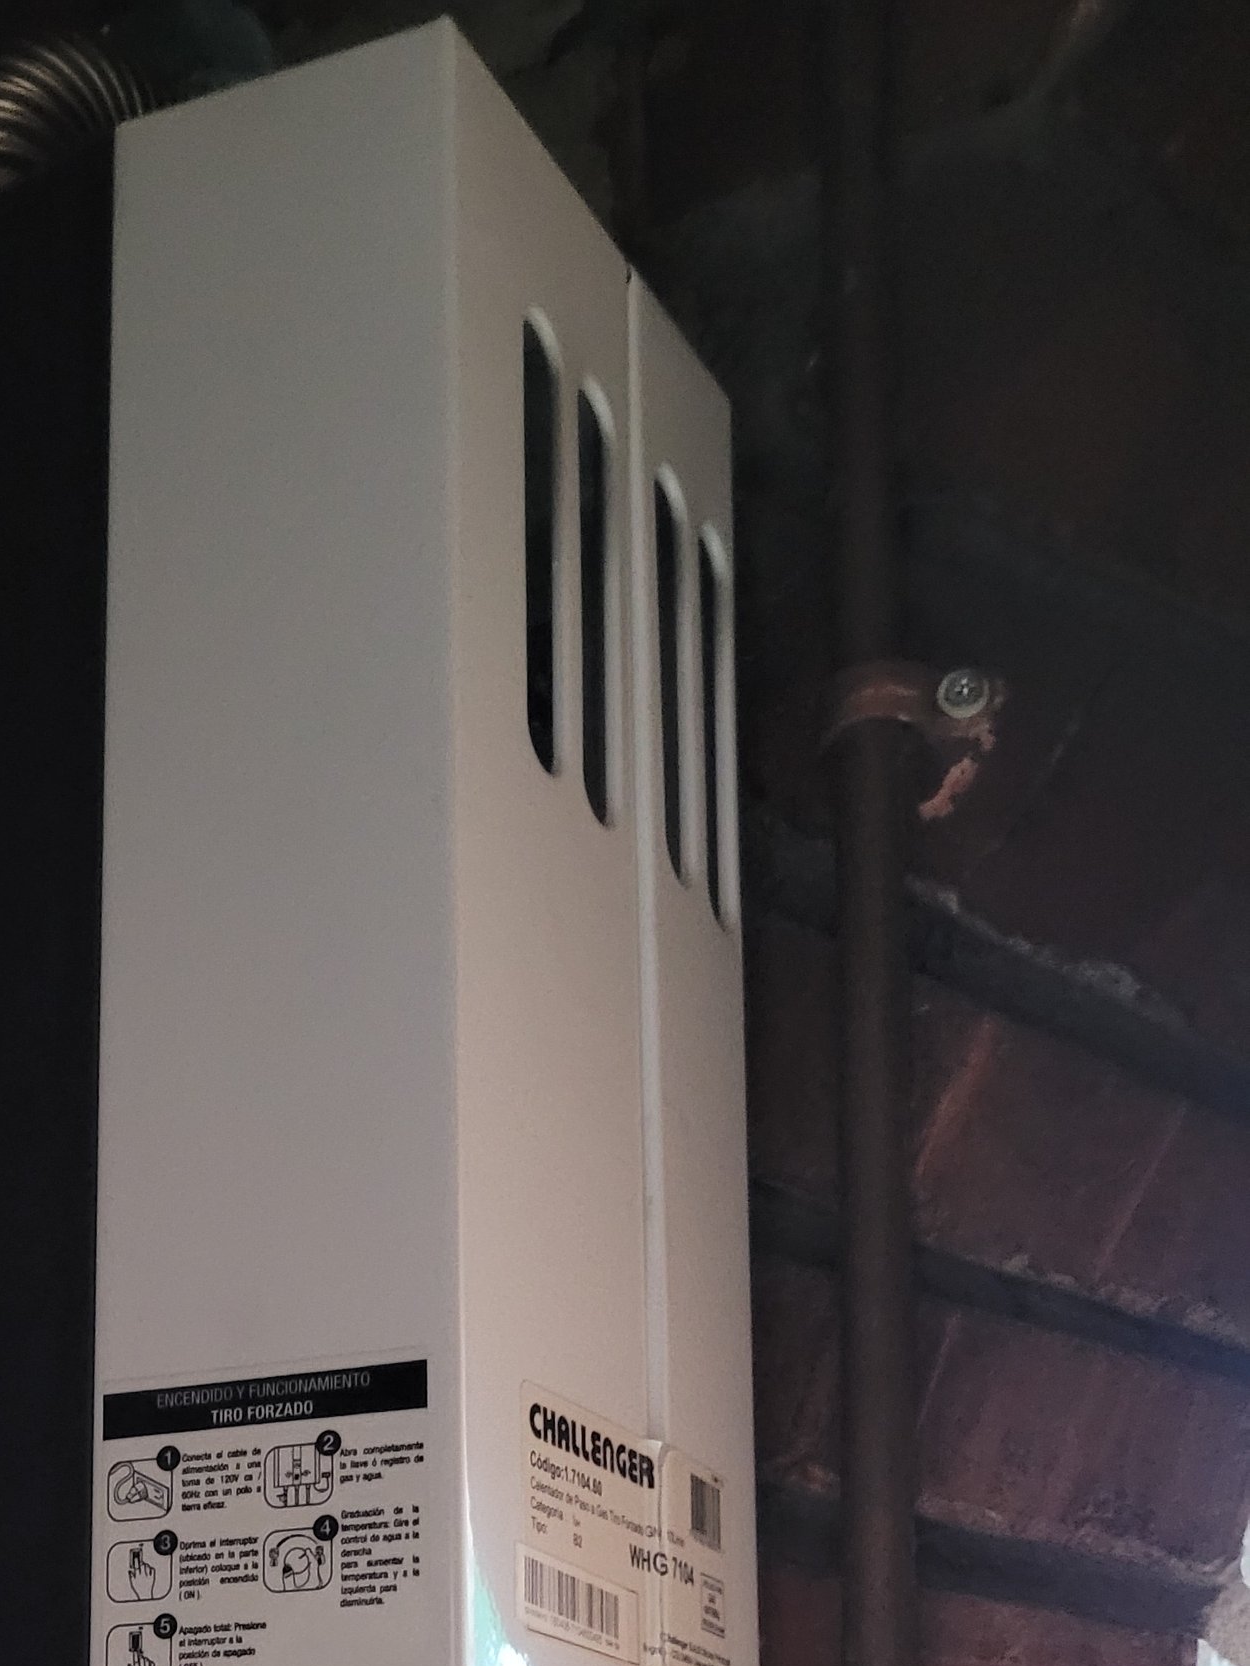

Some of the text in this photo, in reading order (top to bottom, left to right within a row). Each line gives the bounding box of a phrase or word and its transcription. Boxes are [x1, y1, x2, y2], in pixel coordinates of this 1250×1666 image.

[157, 1372, 369, 1407] ENCENDIDO Y FUNCIONAMIENTO
[211, 1400, 312, 1423] TIRO FORZADO
[529, 1402, 655, 1489] CHALLENGER
